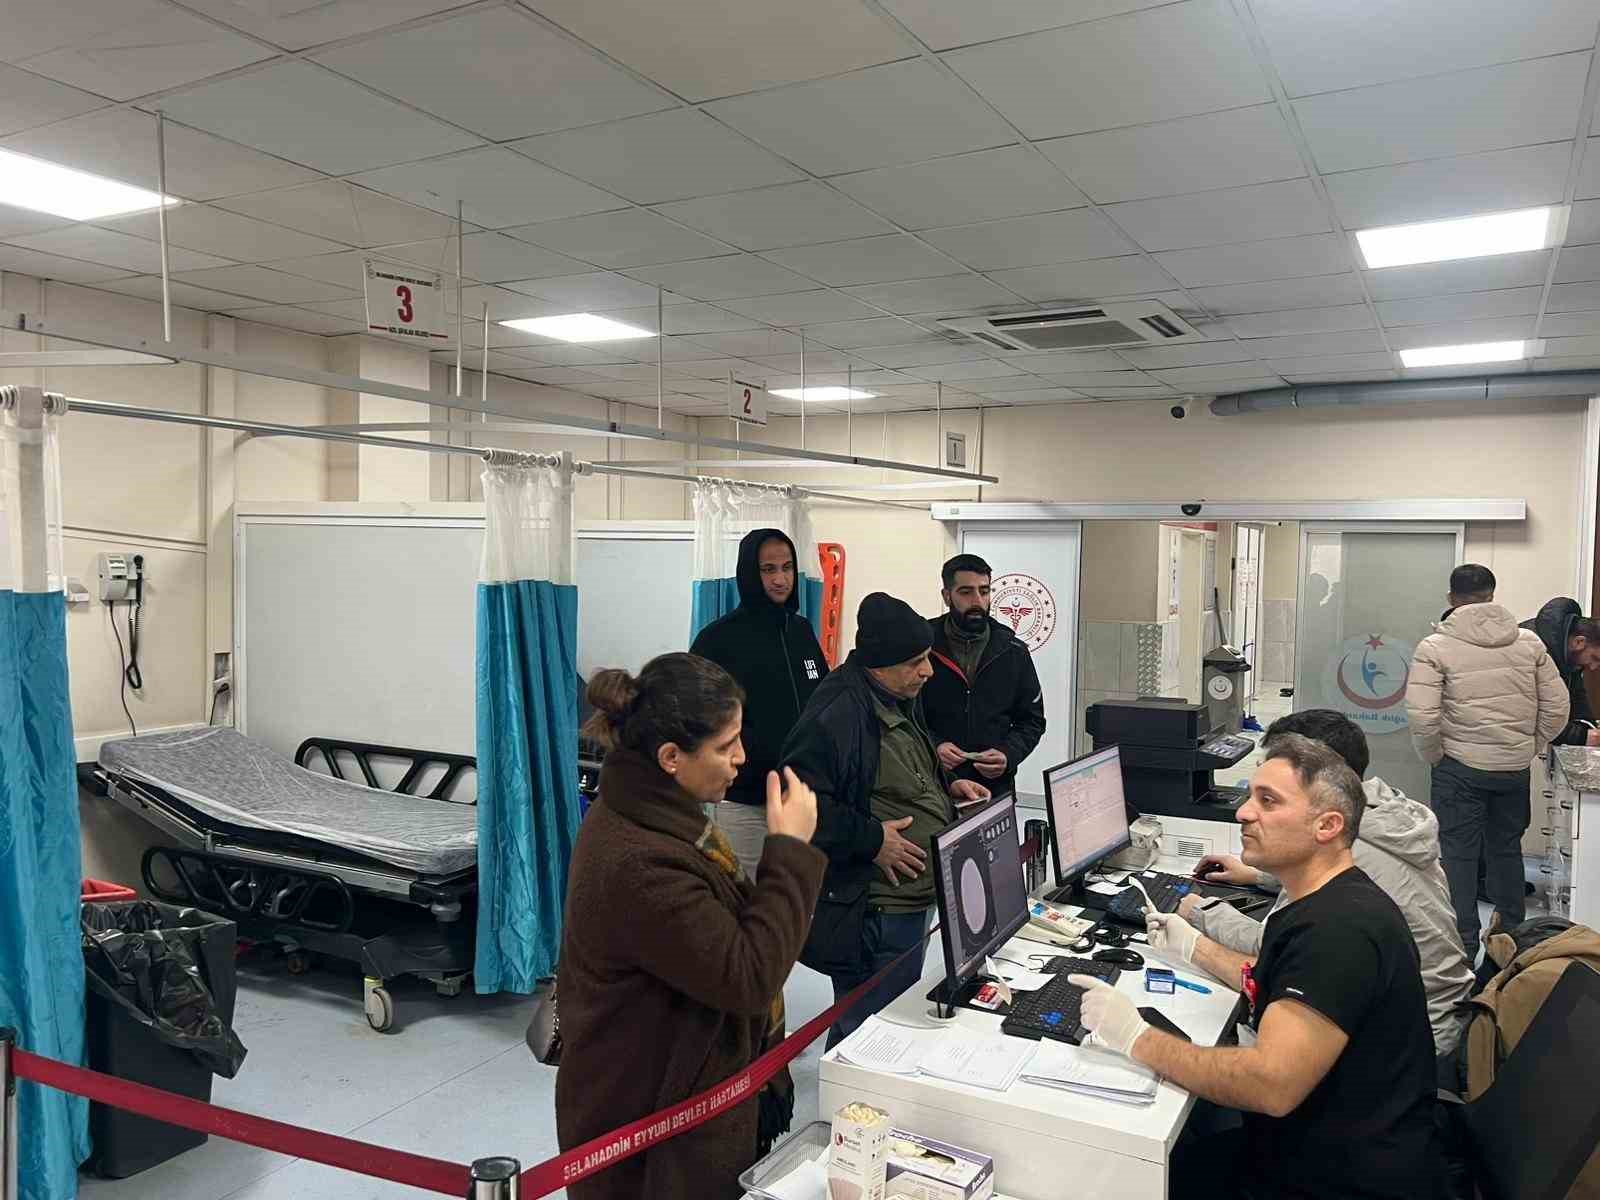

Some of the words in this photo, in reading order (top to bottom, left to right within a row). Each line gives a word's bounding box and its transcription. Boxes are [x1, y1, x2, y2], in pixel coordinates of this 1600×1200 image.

[396, 285, 413, 323] 3
[743, 388, 752, 414] 2
[562, 1136, 631, 1181] SELAHADDİN
[633, 1117, 671, 1147] EYYUBİ
[671, 1101, 707, 1130] DEVLET
[709, 1072, 752, 1112] HASTANESİ
